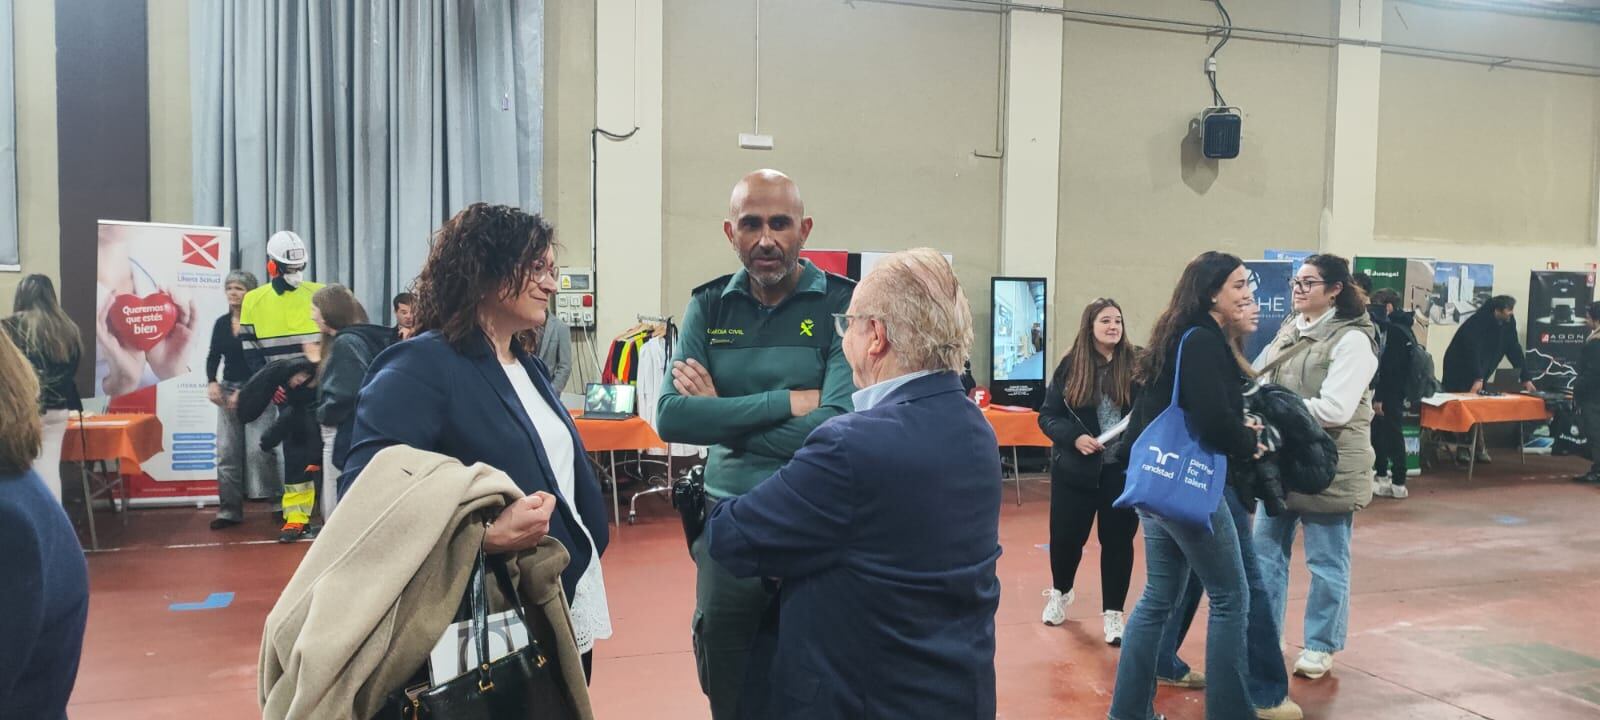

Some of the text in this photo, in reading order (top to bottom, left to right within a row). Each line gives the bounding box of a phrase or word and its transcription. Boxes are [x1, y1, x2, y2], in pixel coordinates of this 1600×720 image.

[122, 304, 164, 316] Queremos
[1257, 297, 1285, 312] HE
[126, 317, 141, 325] que
[134, 323, 157, 334] bien
[706, 327, 727, 335] GARDIA
[1142, 464, 1174, 479] randstad
[1187, 466, 1199, 477] for
